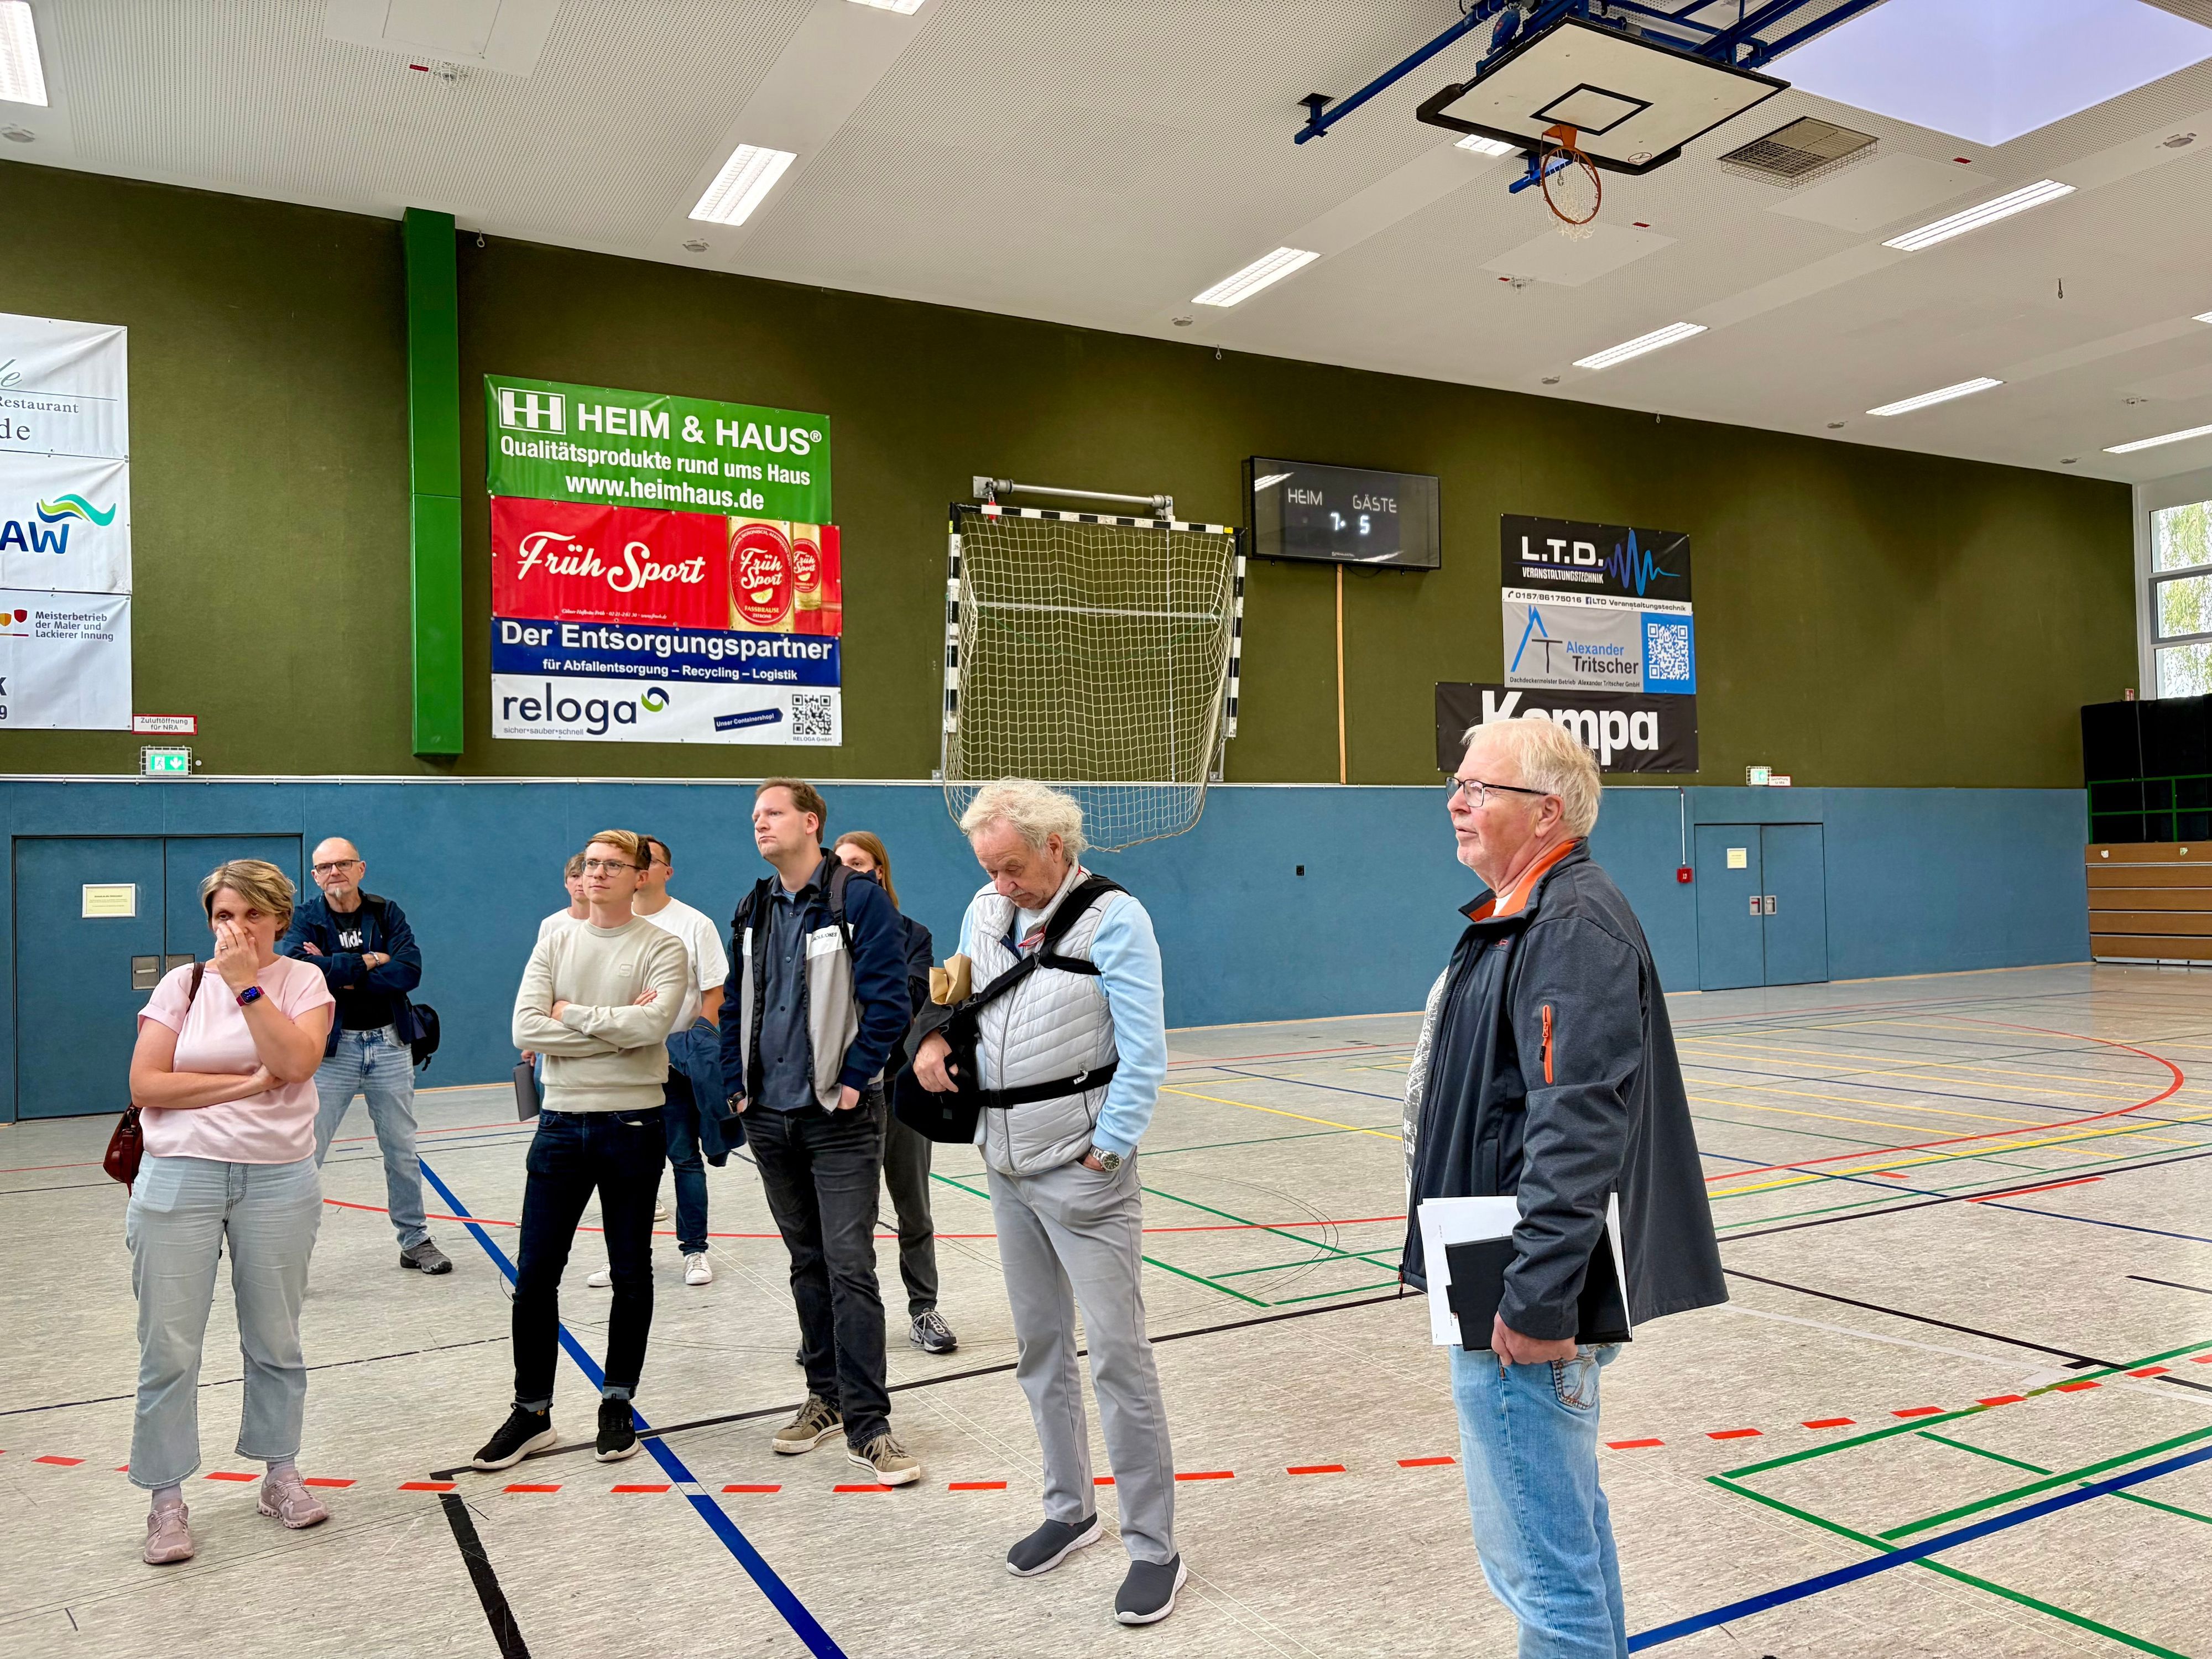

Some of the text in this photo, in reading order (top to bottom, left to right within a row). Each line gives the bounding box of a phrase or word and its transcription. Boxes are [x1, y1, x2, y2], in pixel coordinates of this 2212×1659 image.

[578, 403, 670, 439] HEIM
[682, 415, 706, 444] &
[501, 435, 810, 486] Qualitätsprodukte rund ums Haus
[565, 476, 764, 510] www.heimhaus.de
[1288, 488, 1397, 513] HEIM GÄSTE
[0, 520, 69, 554] AW
[1360, 515, 1370, 534] 5
[517, 531, 606, 580] Früh
[607, 541, 706, 592] Sport
[740, 547, 782, 572] Früh
[1522, 536, 1604, 567] L.T.D.
[741, 566, 782, 589] Sport
[1522, 567, 1604, 584] VERANSTALTUNGSTECHNIK
[1516, 592, 1582, 603] 0157/86175016
[1609, 599, 1686, 612] Veranstaltungstechnik
[35, 611, 107, 622] Meisterbetrieb
[35, 620, 101, 630] der Maler und
[35, 629, 114, 642] Lackierer Innung
[502, 621, 832, 660] Der Entsorgungspartner
[1567, 641, 1624, 656] Alexander
[542, 659, 561, 671] für
[564, 660, 669, 677] Abfallentsorgung
[682, 665, 739, 680] Recycling
[753, 668, 798, 681] Logistik
[1572, 655, 1639, 675] Tritscher
[503, 682, 637, 735] reloga
[1482, 690, 1658, 765] Kmpa
